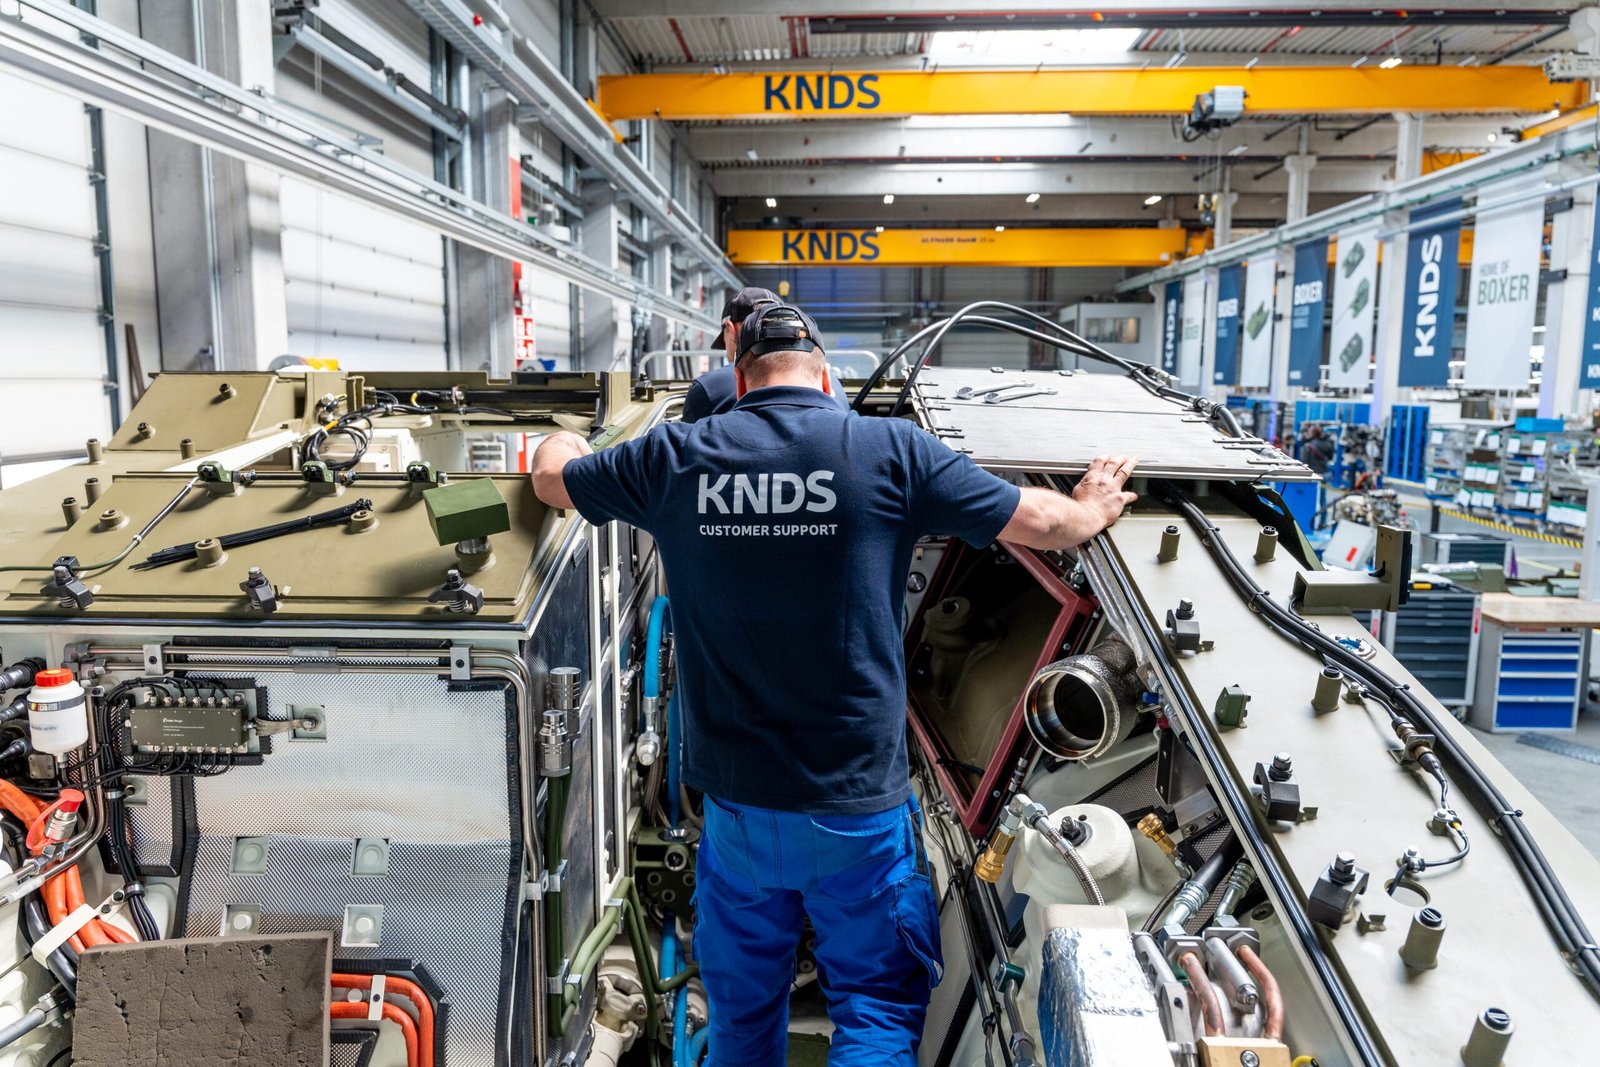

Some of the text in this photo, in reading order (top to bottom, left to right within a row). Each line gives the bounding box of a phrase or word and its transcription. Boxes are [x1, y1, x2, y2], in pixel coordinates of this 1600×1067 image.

[764, 74, 881, 110] KNDS
[782, 230, 881, 260] KNDS
[1479, 259, 1511, 276] HOME OF
[1414, 234, 1443, 357] KNDS
[1477, 274, 1530, 305] BOXER
[1164, 298, 1177, 369] KNDS
[698, 470, 837, 514] KNDS
[700, 524, 838, 536] CUSTOMER SUPPORT
